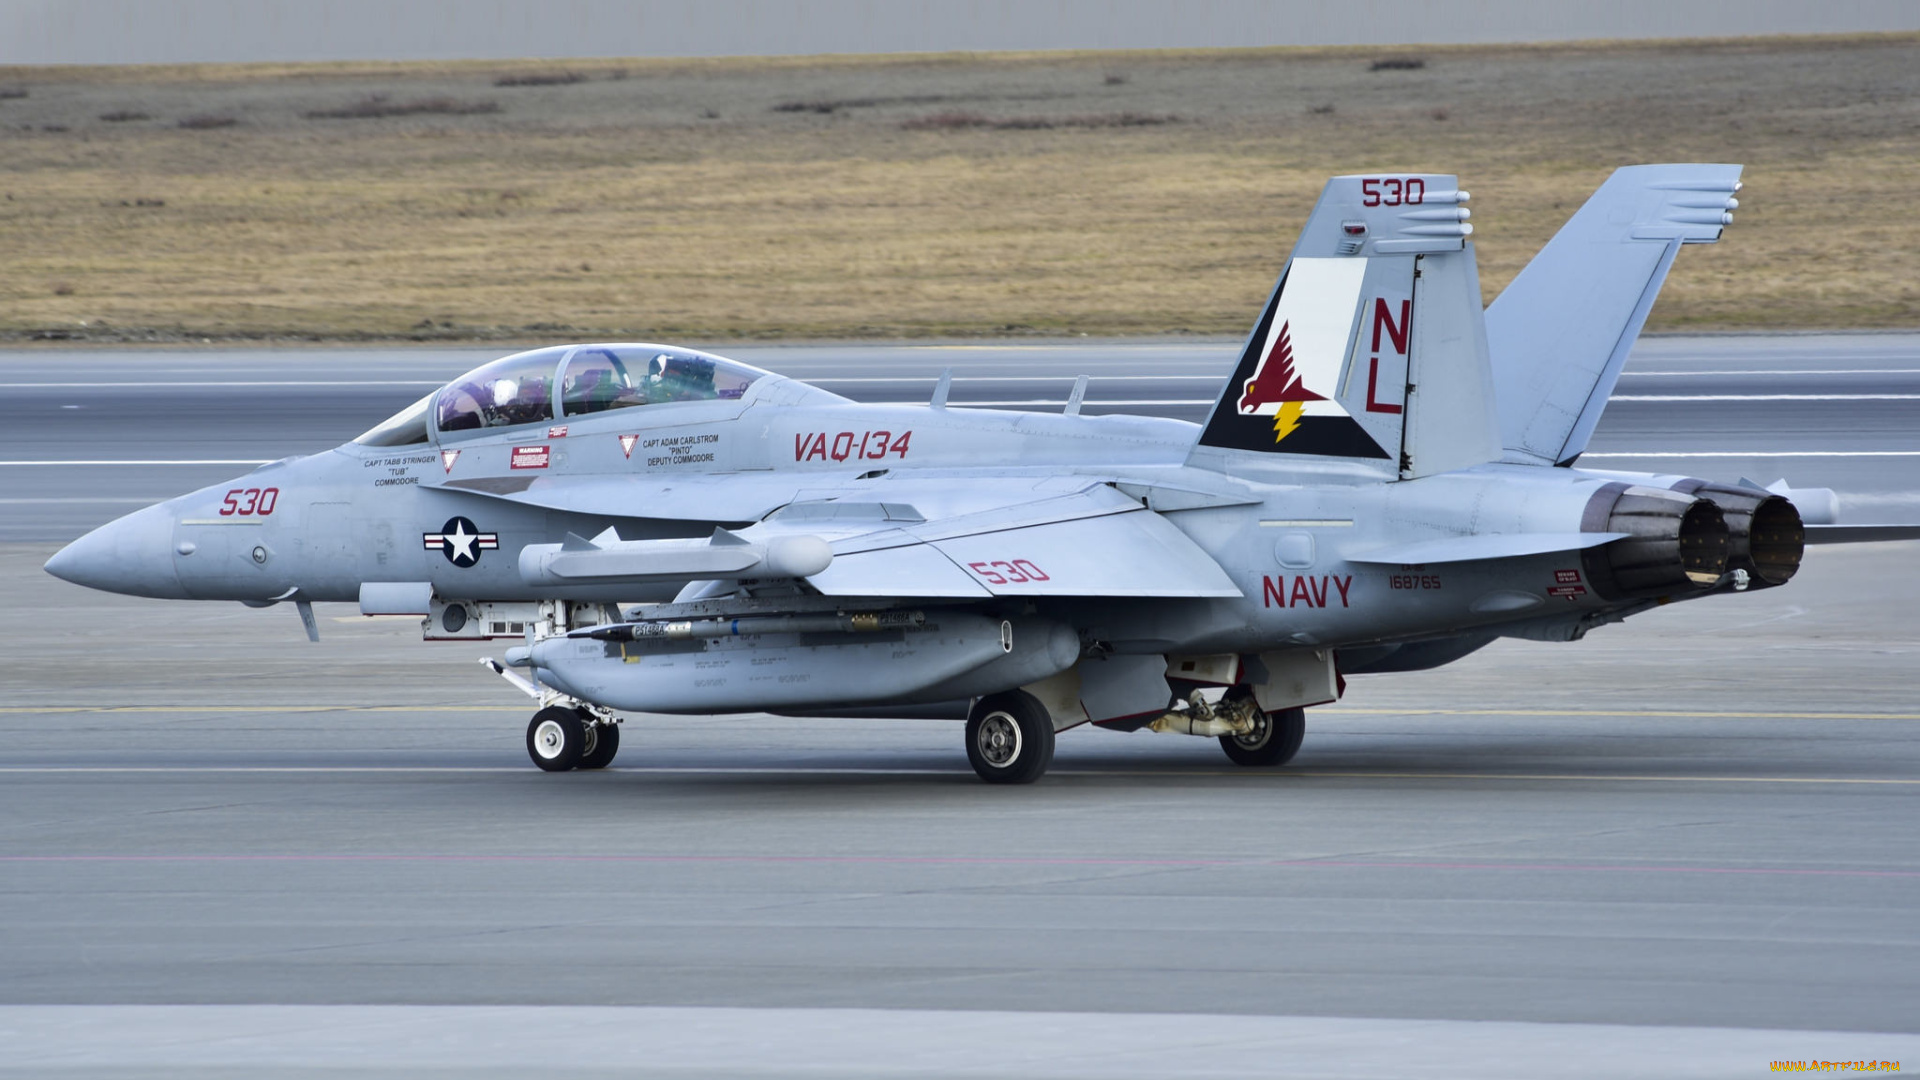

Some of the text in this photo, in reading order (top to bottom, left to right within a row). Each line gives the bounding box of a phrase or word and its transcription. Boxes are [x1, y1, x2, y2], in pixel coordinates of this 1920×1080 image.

[1362, 178, 1424, 207] 530
[643, 434, 719, 448] CAPT ADAM CARLSTROM
[795, 430, 912, 462] VAQ-134
[669, 445, 692, 455] "PINTO"
[364, 455, 436, 467] CAPT TABB STRINGER
[648, 453, 714, 466] DEPUTY COMMODORE
[388, 467, 409, 476] "TUB"
[374, 477, 419, 487] COMMODORE
[219, 488, 279, 516] 530
[968, 559, 1050, 584] 530
[1389, 575, 1441, 590] 168765
[1263, 575, 1352, 608] NAVY
